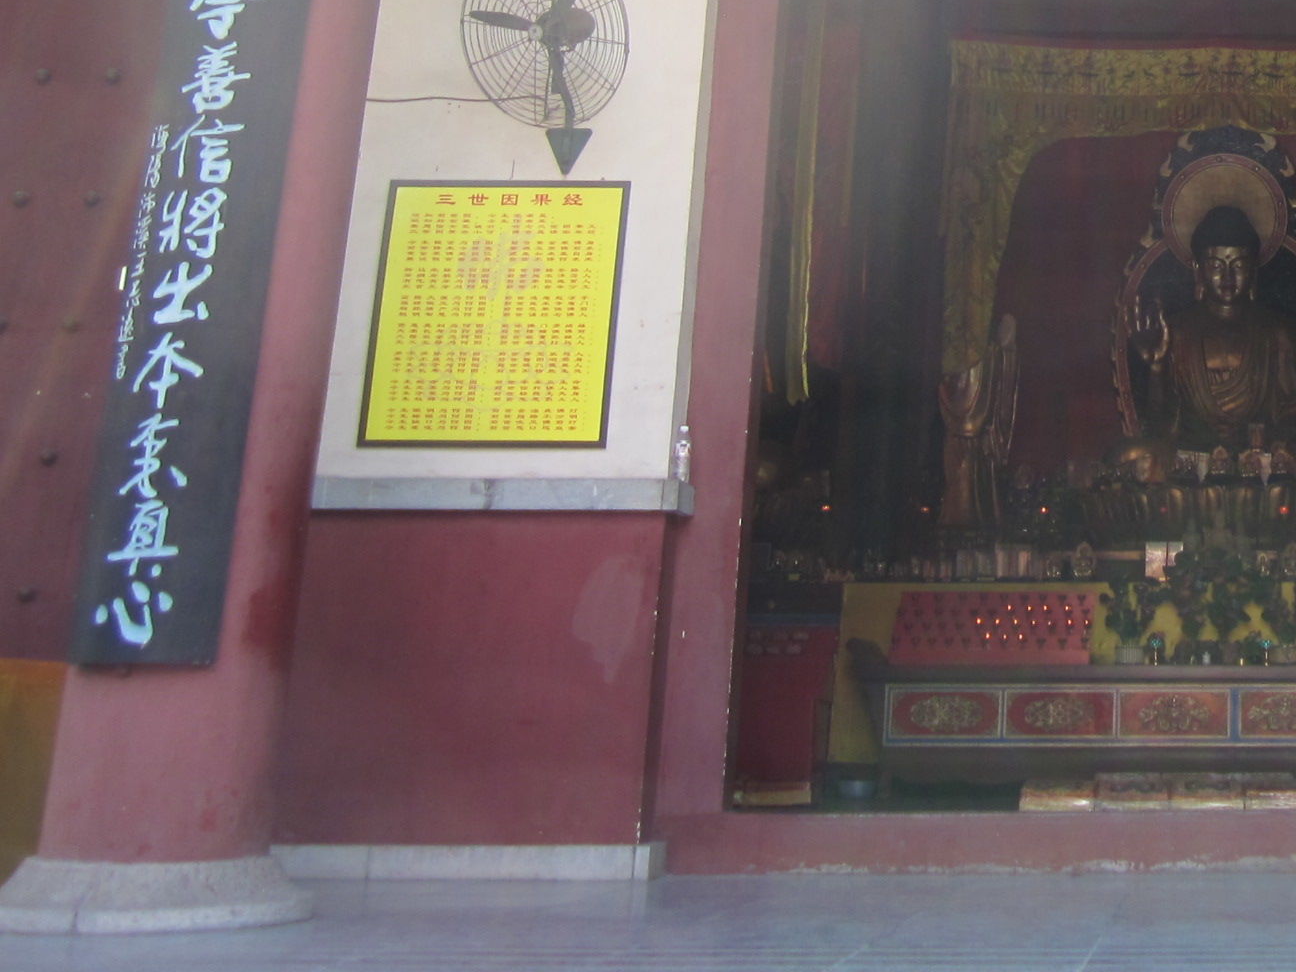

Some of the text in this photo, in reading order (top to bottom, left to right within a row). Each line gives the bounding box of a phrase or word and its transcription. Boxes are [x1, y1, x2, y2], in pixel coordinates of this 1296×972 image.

[435, 193, 584, 206] 三世因果经
